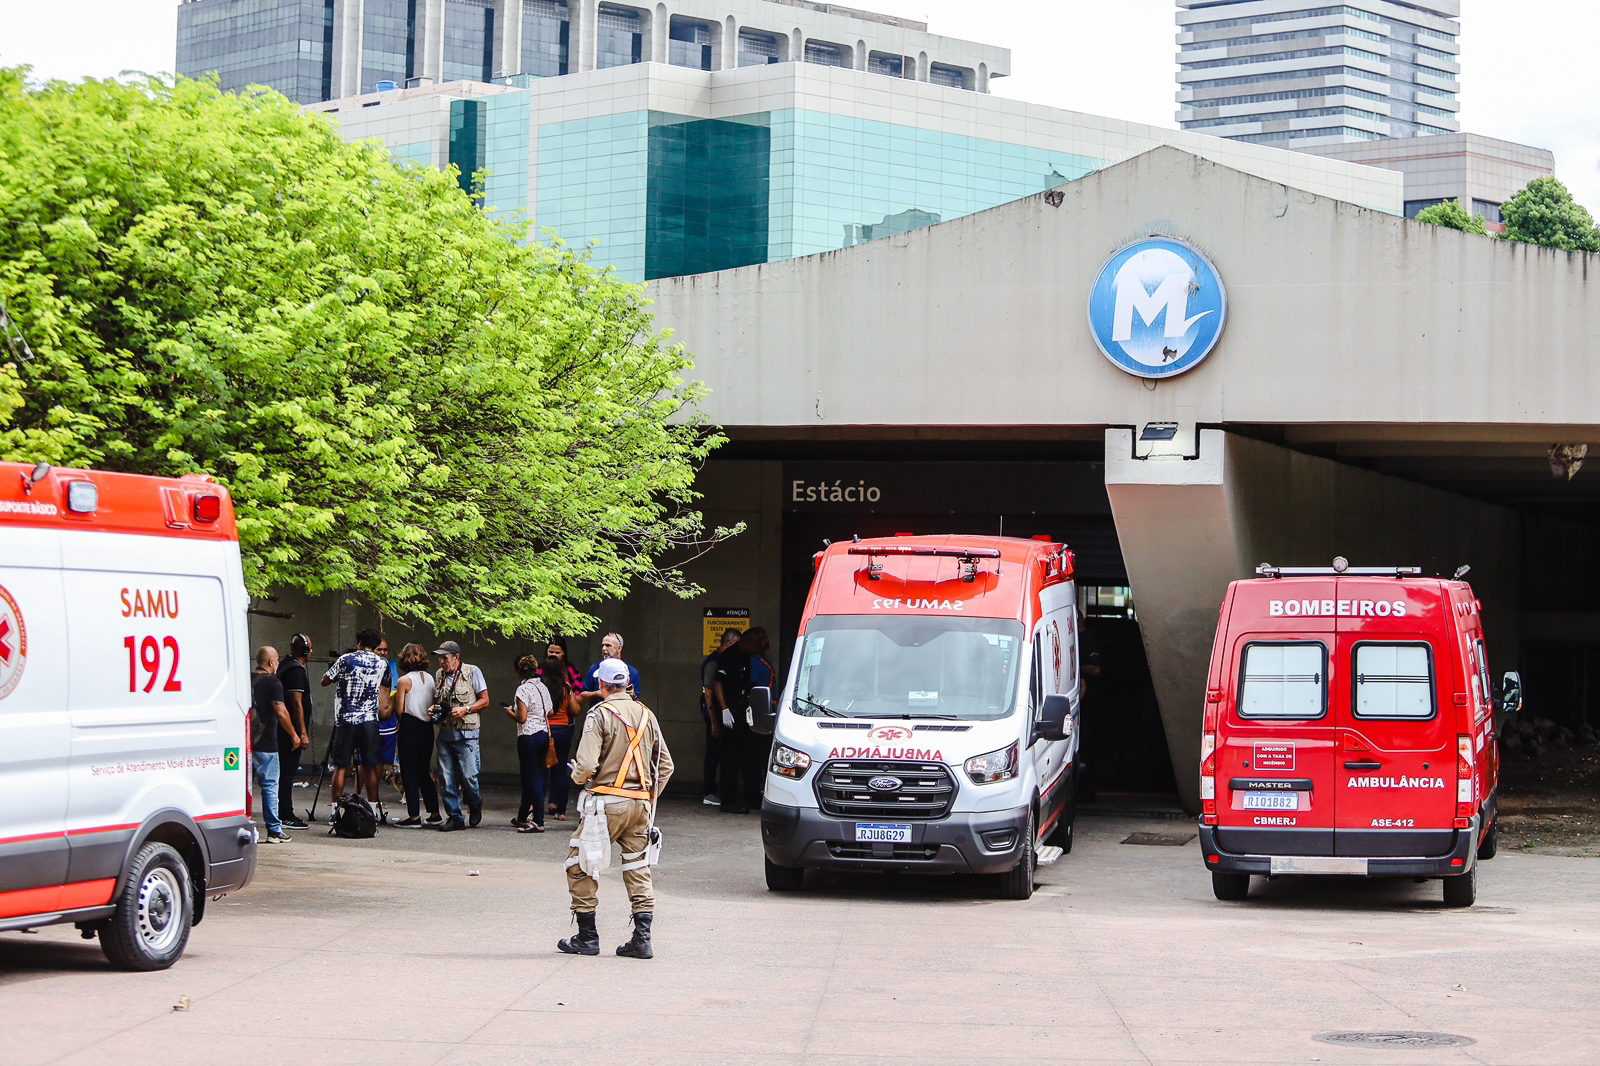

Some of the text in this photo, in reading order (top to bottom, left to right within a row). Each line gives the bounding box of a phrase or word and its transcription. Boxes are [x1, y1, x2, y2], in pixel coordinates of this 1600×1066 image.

[792, 479, 881, 502] Estácio
[32, 500, 58, 516] BÁSICO
[120, 587, 179, 619] SAMU
[1269, 599, 1407, 617] BOMBEIROS
[726, 609, 748, 617] ATENÇÃO
[123, 635, 182, 694] 192
[91, 755, 220, 776] Serviço de Atendimento Móvel de Urgência
[875, 779, 893, 788] Ford
[1347, 774, 1445, 788] AMBULÂNCIA
[1253, 816, 1297, 826] CBMERJ
[1370, 818, 1414, 827] ASE-412
[860, 829, 905, 841] RJU8G29
